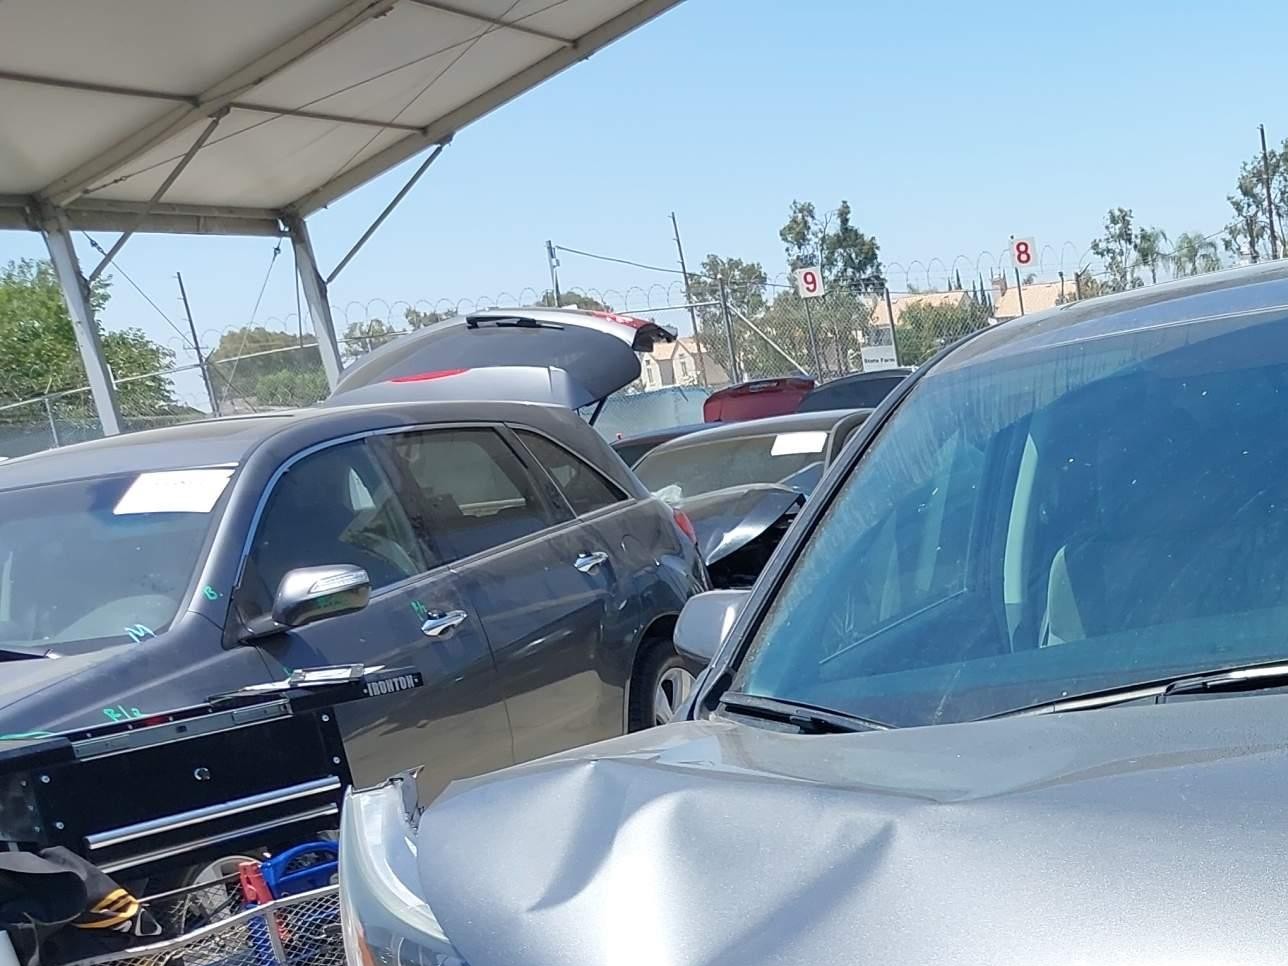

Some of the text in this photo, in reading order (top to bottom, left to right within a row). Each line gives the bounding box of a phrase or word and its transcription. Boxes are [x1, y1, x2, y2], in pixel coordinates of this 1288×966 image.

[1014, 241, 1031, 264] 8
[803, 271, 818, 293] 9
[366, 674, 415, 697] IRONTON
